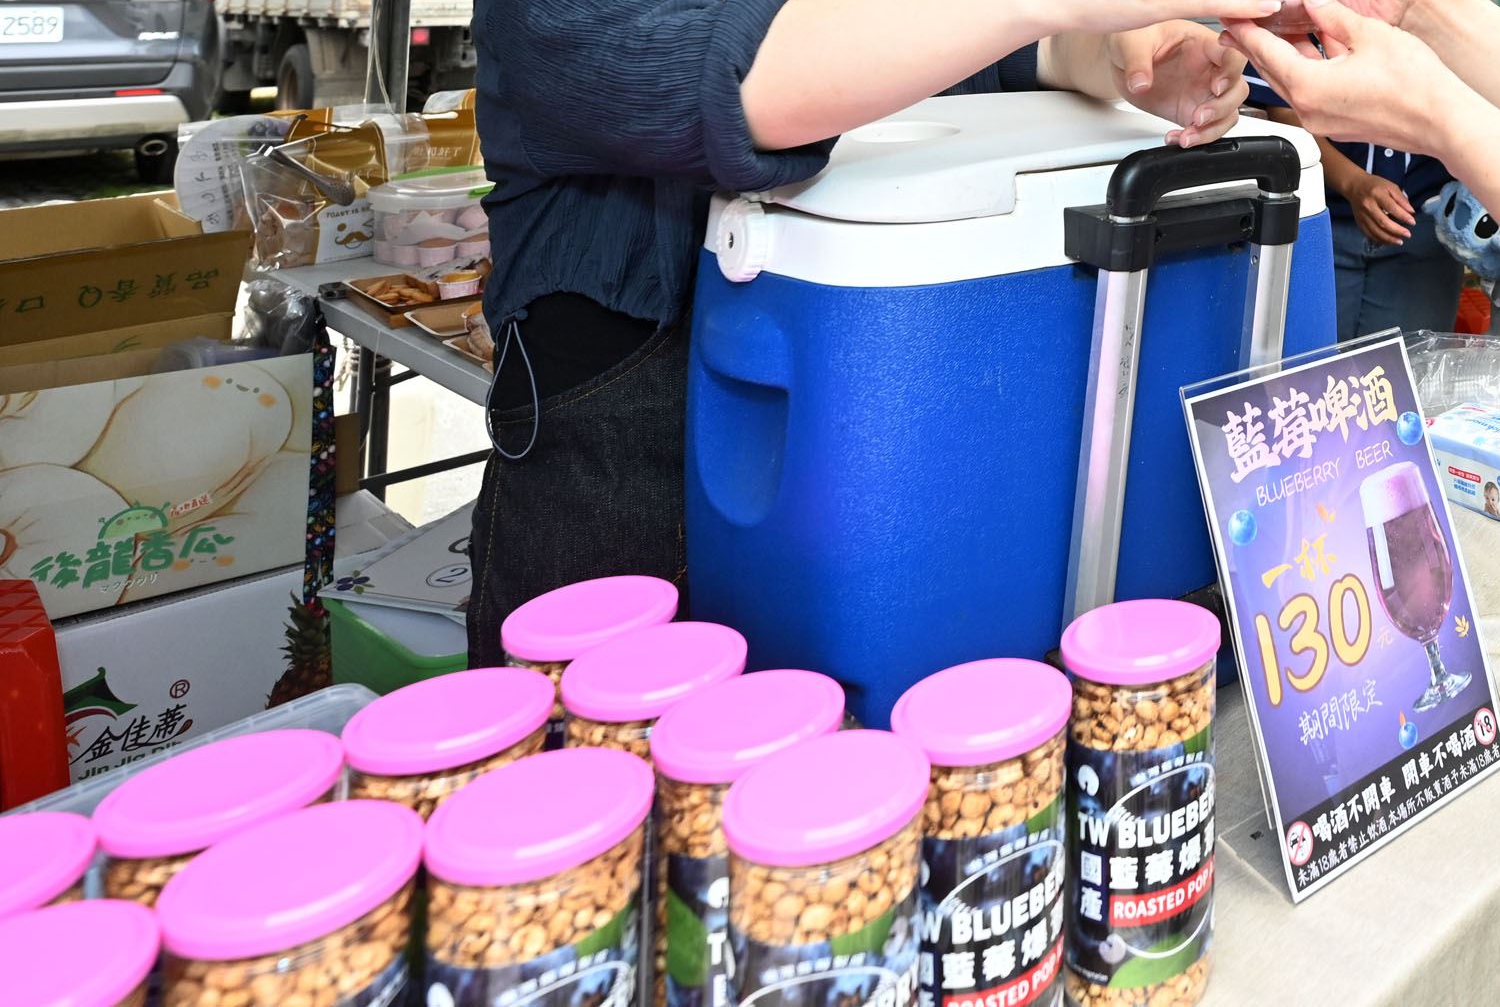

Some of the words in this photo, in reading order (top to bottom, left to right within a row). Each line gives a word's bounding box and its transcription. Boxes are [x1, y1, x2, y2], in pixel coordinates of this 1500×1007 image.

[2, 15, 59, 37] 2589
[1221, 365, 1398, 484] 藍莓啤酒
[1256, 457, 1342, 507] BLUEBERRY
[1355, 440, 1394, 469] BEER
[1261, 534, 1337, 588] 一杯
[1254, 573, 1372, 706] 130
[1299, 679, 1383, 746] 期間限定
[1312, 775, 1396, 843] 喝酒不開車
[1401, 723, 1477, 790] 開車不喝酒
[1078, 812, 1110, 847] TW
[1113, 886, 1185, 920] ROASTED
